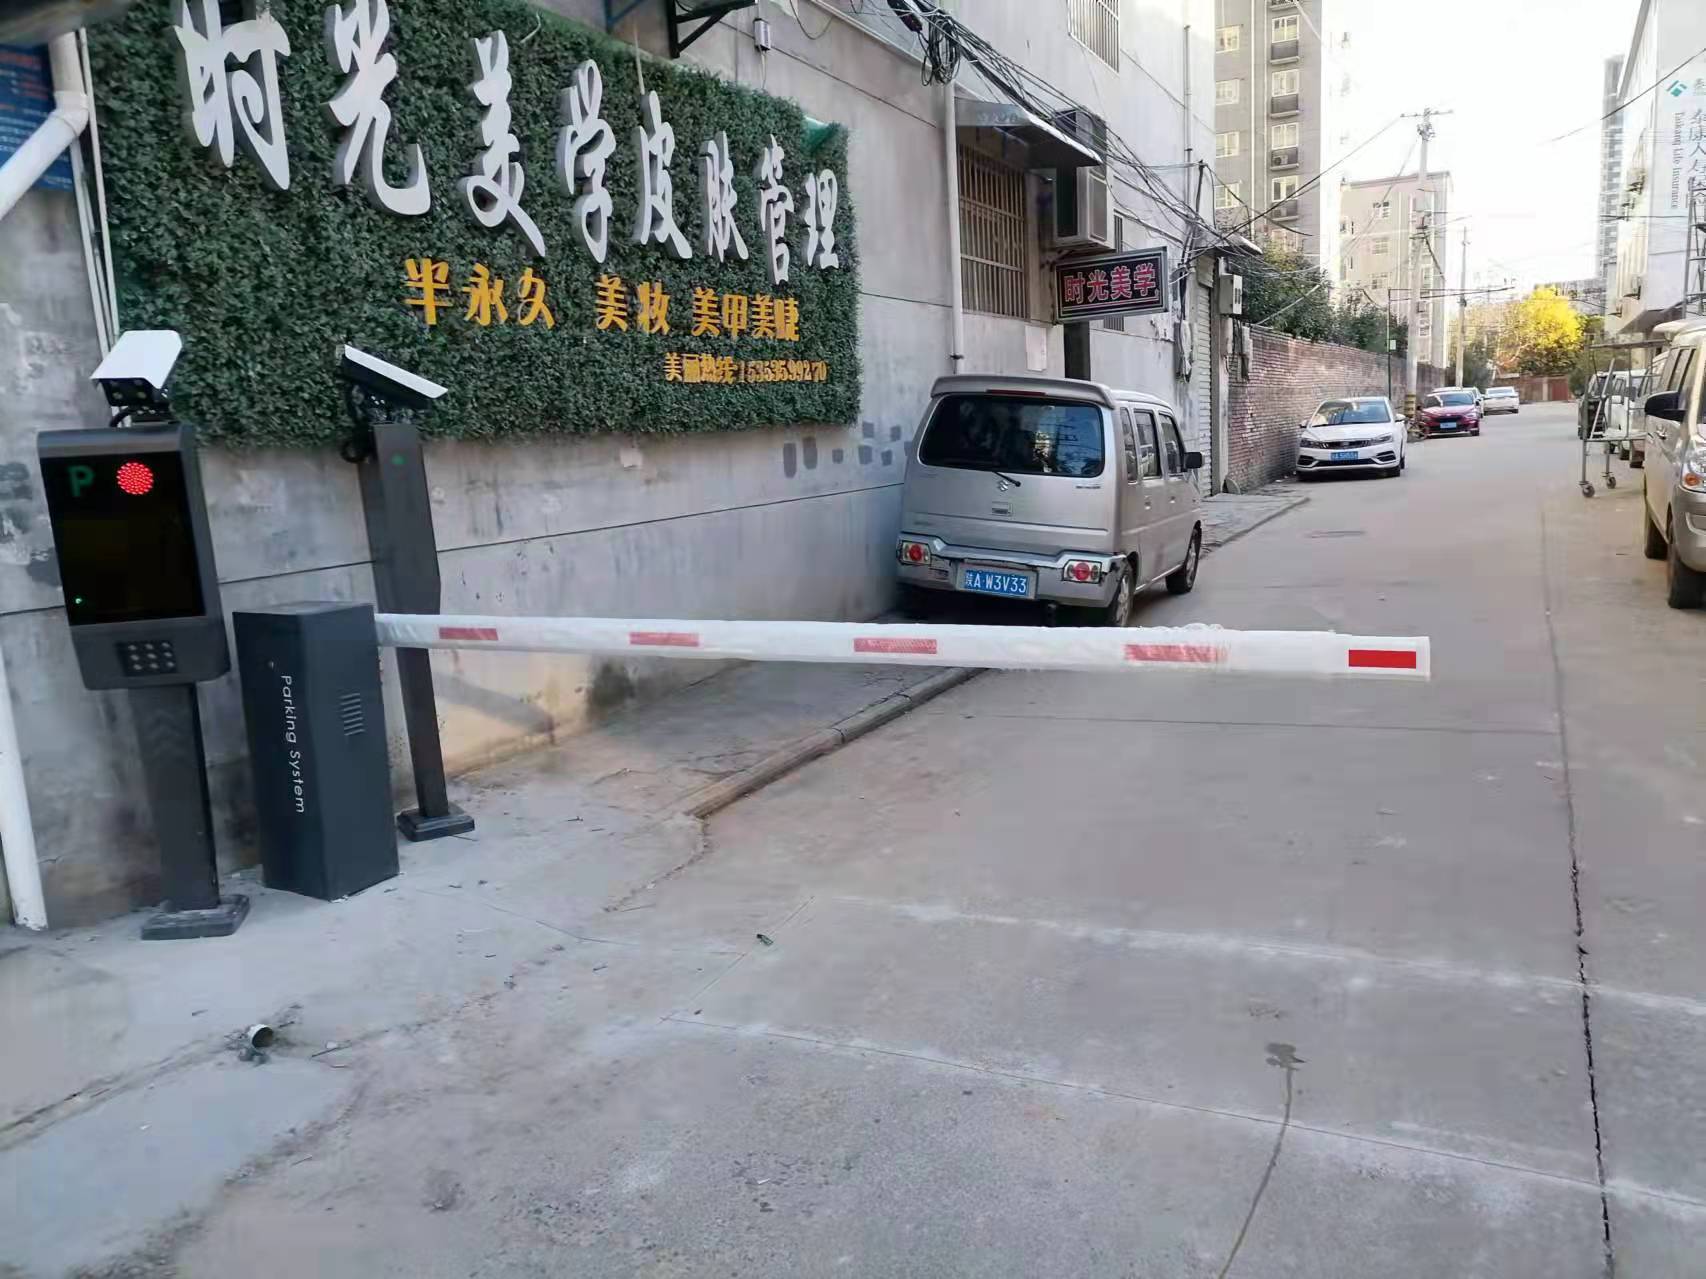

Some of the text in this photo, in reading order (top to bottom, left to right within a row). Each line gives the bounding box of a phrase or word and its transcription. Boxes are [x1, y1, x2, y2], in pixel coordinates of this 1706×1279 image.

[405, 257, 557, 330] 半永久
[597, 273, 671, 336] 美妆
[1063, 262, 1157, 304] 时光美学
[67, 464, 96, 498] P
[280, 675, 305, 814] Parking System
